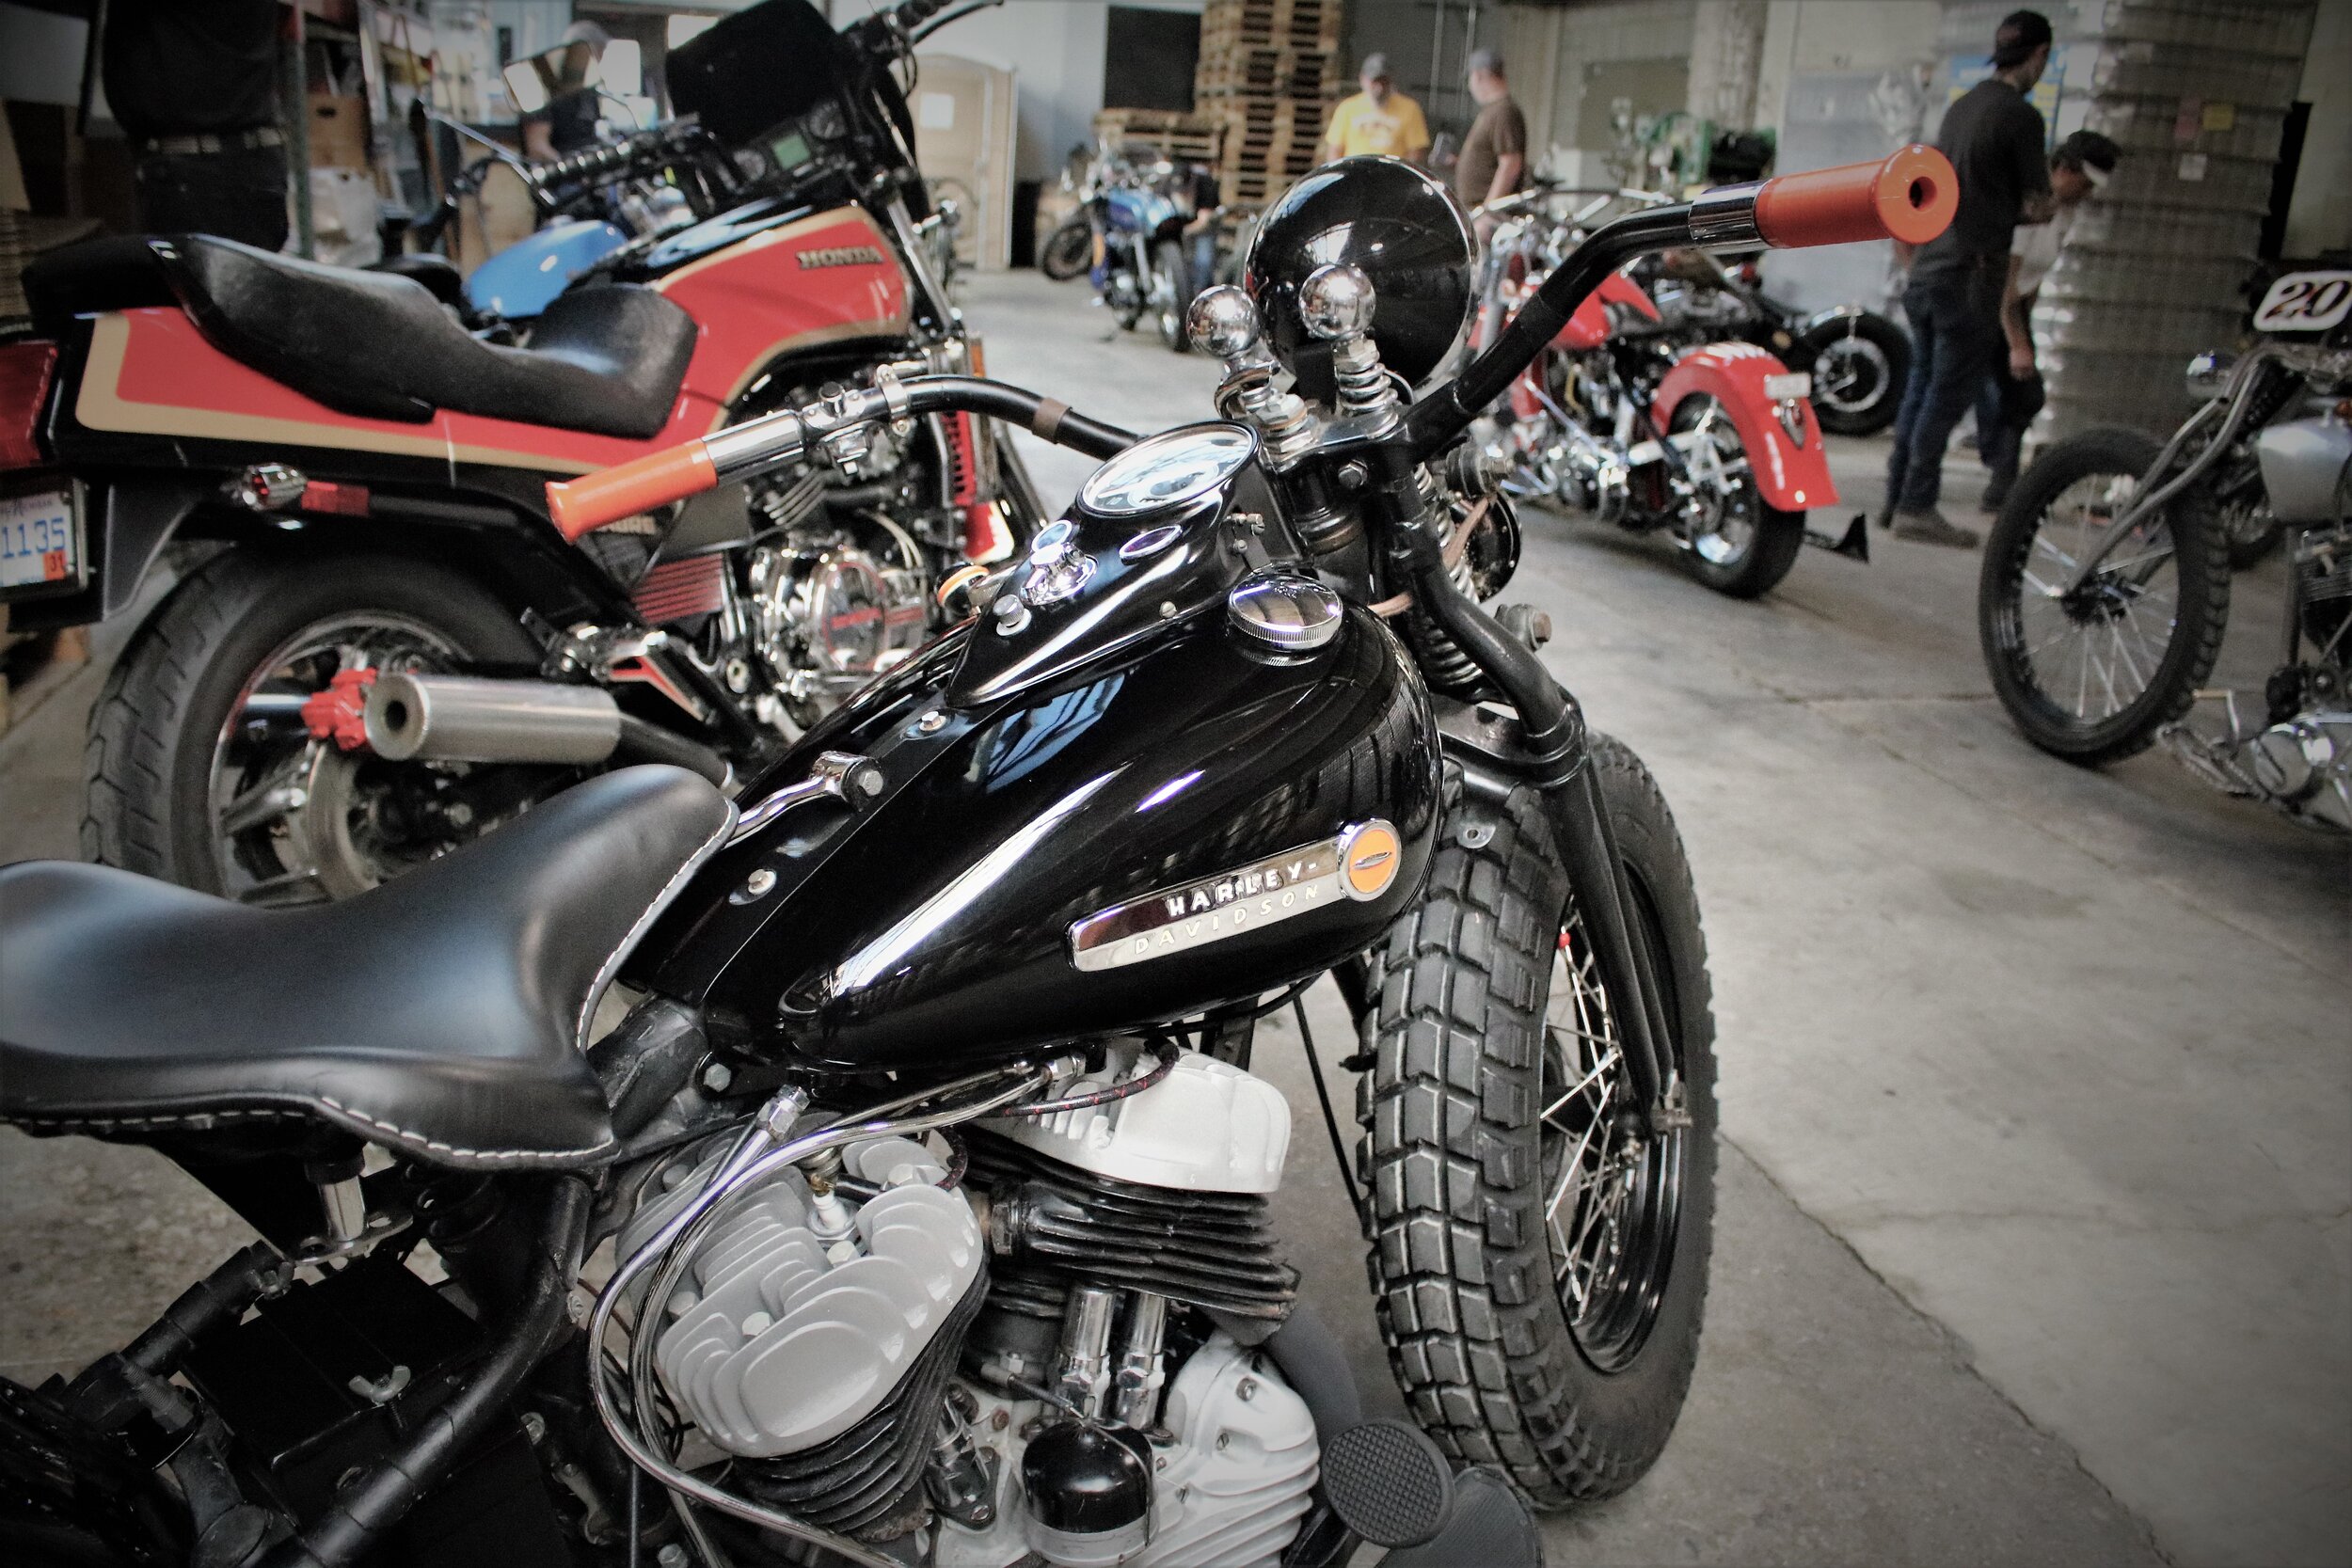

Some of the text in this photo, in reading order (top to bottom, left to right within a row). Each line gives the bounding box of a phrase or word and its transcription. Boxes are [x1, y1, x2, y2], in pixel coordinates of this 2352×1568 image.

[795, 245, 882, 270] HONDA
[2264, 280, 2351, 320] 20
[1168, 862, 1318, 918] HARLEY-
[1133, 884, 1318, 955] DAVIDSON
